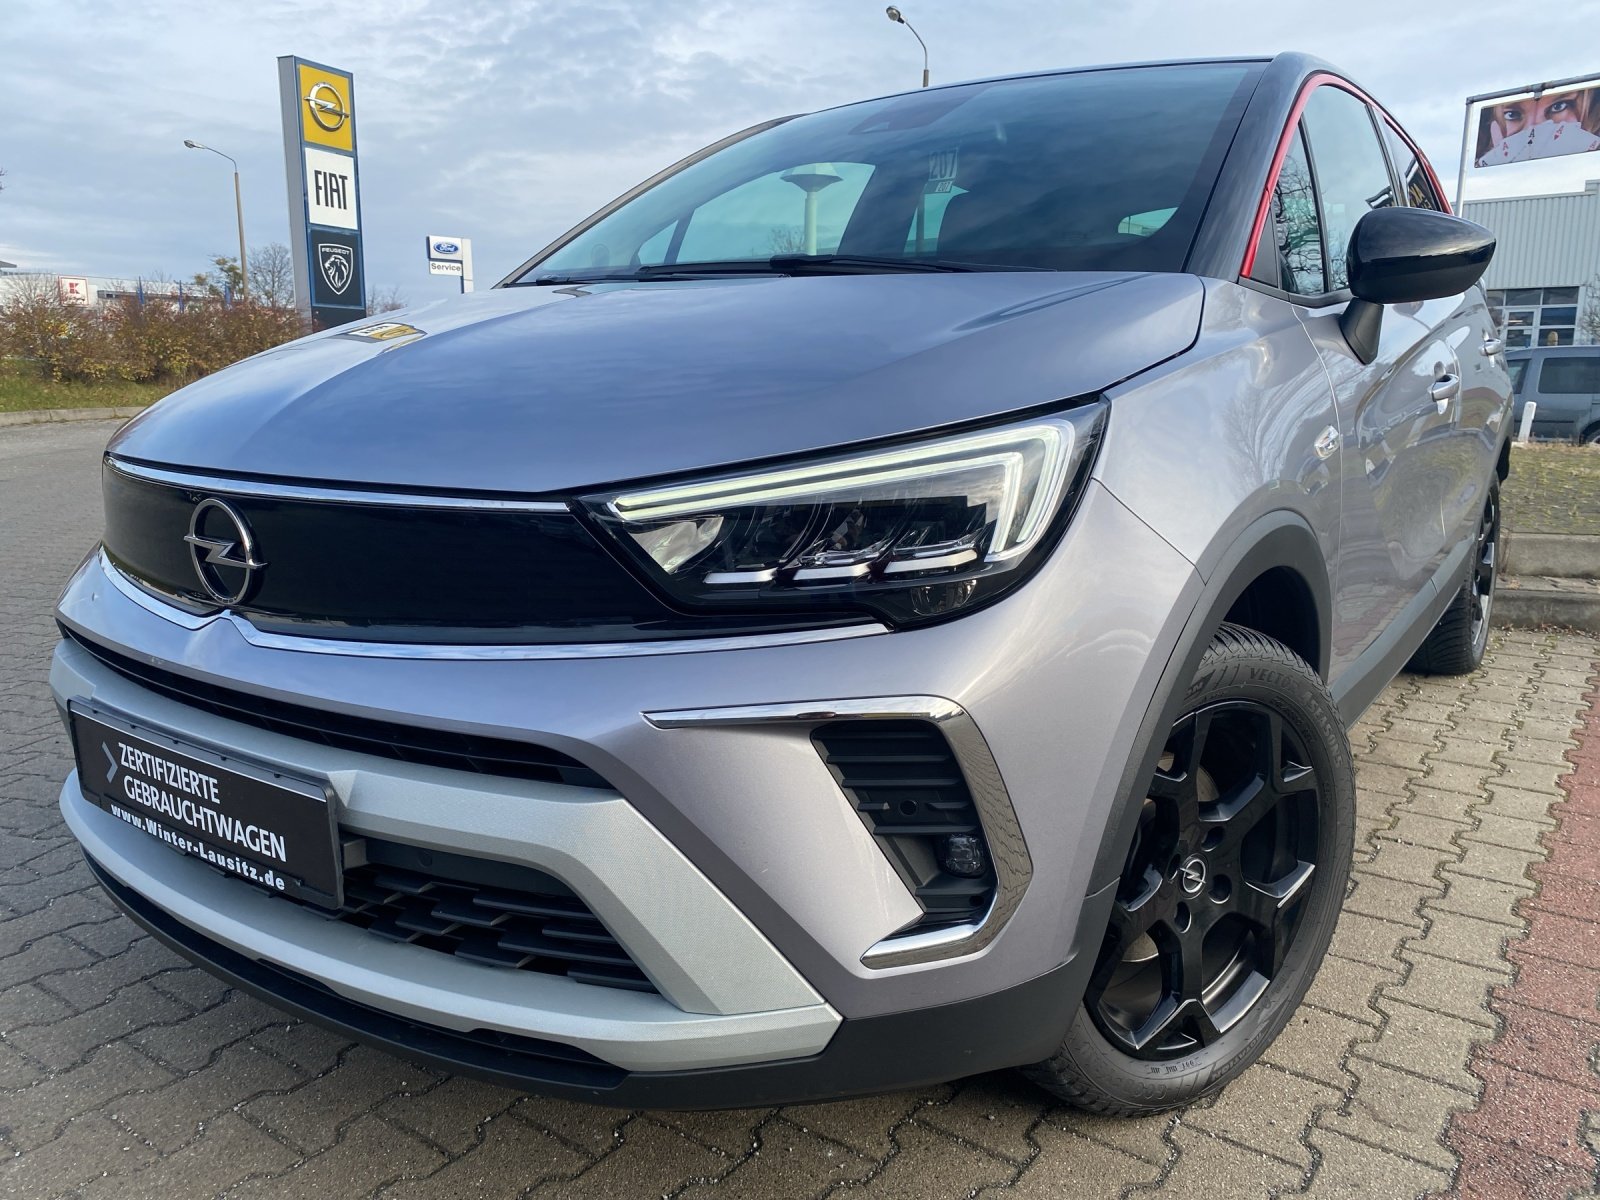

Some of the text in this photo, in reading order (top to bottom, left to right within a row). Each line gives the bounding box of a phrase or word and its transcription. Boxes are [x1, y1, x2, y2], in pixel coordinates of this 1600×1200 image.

[930, 151, 956, 179] 207
[314, 169, 348, 210] FIAT
[321, 247, 350, 255] PEUGEOT
[431, 263, 461, 272] Service
[1250, 667, 1299, 696] VECTOR
[118, 742, 221, 804] ZERTIFIZIERTE
[123, 775, 287, 863] GEBRAUCHTWAGEN
[110, 804, 286, 891] www.Winter-Lausitz.de
